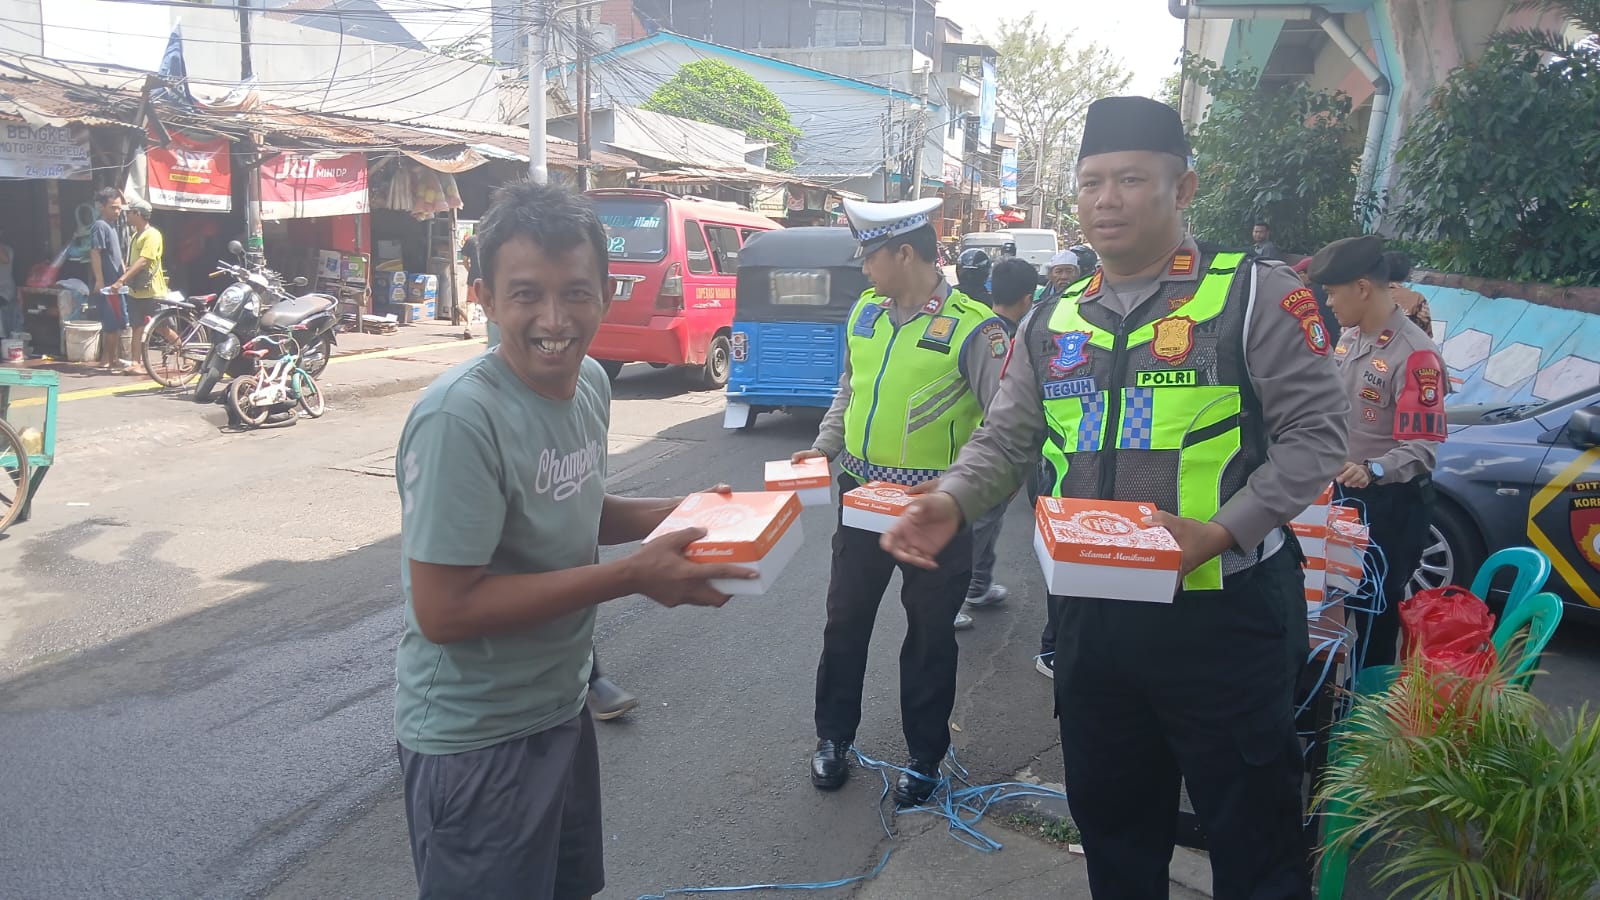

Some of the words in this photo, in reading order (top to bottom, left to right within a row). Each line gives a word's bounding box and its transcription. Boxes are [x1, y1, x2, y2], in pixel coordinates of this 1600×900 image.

[46, 145, 88, 159] SEPEDA
[275, 153, 317, 179] J&T
[1283, 290, 1313, 308] POLDA
[1141, 371, 1192, 385] POLRI
[1363, 370, 1386, 389] POLRI
[1045, 380, 1092, 398] TEGUH
[1079, 549, 1111, 560] Selamat
[1113, 551, 1156, 563] Menikmati
